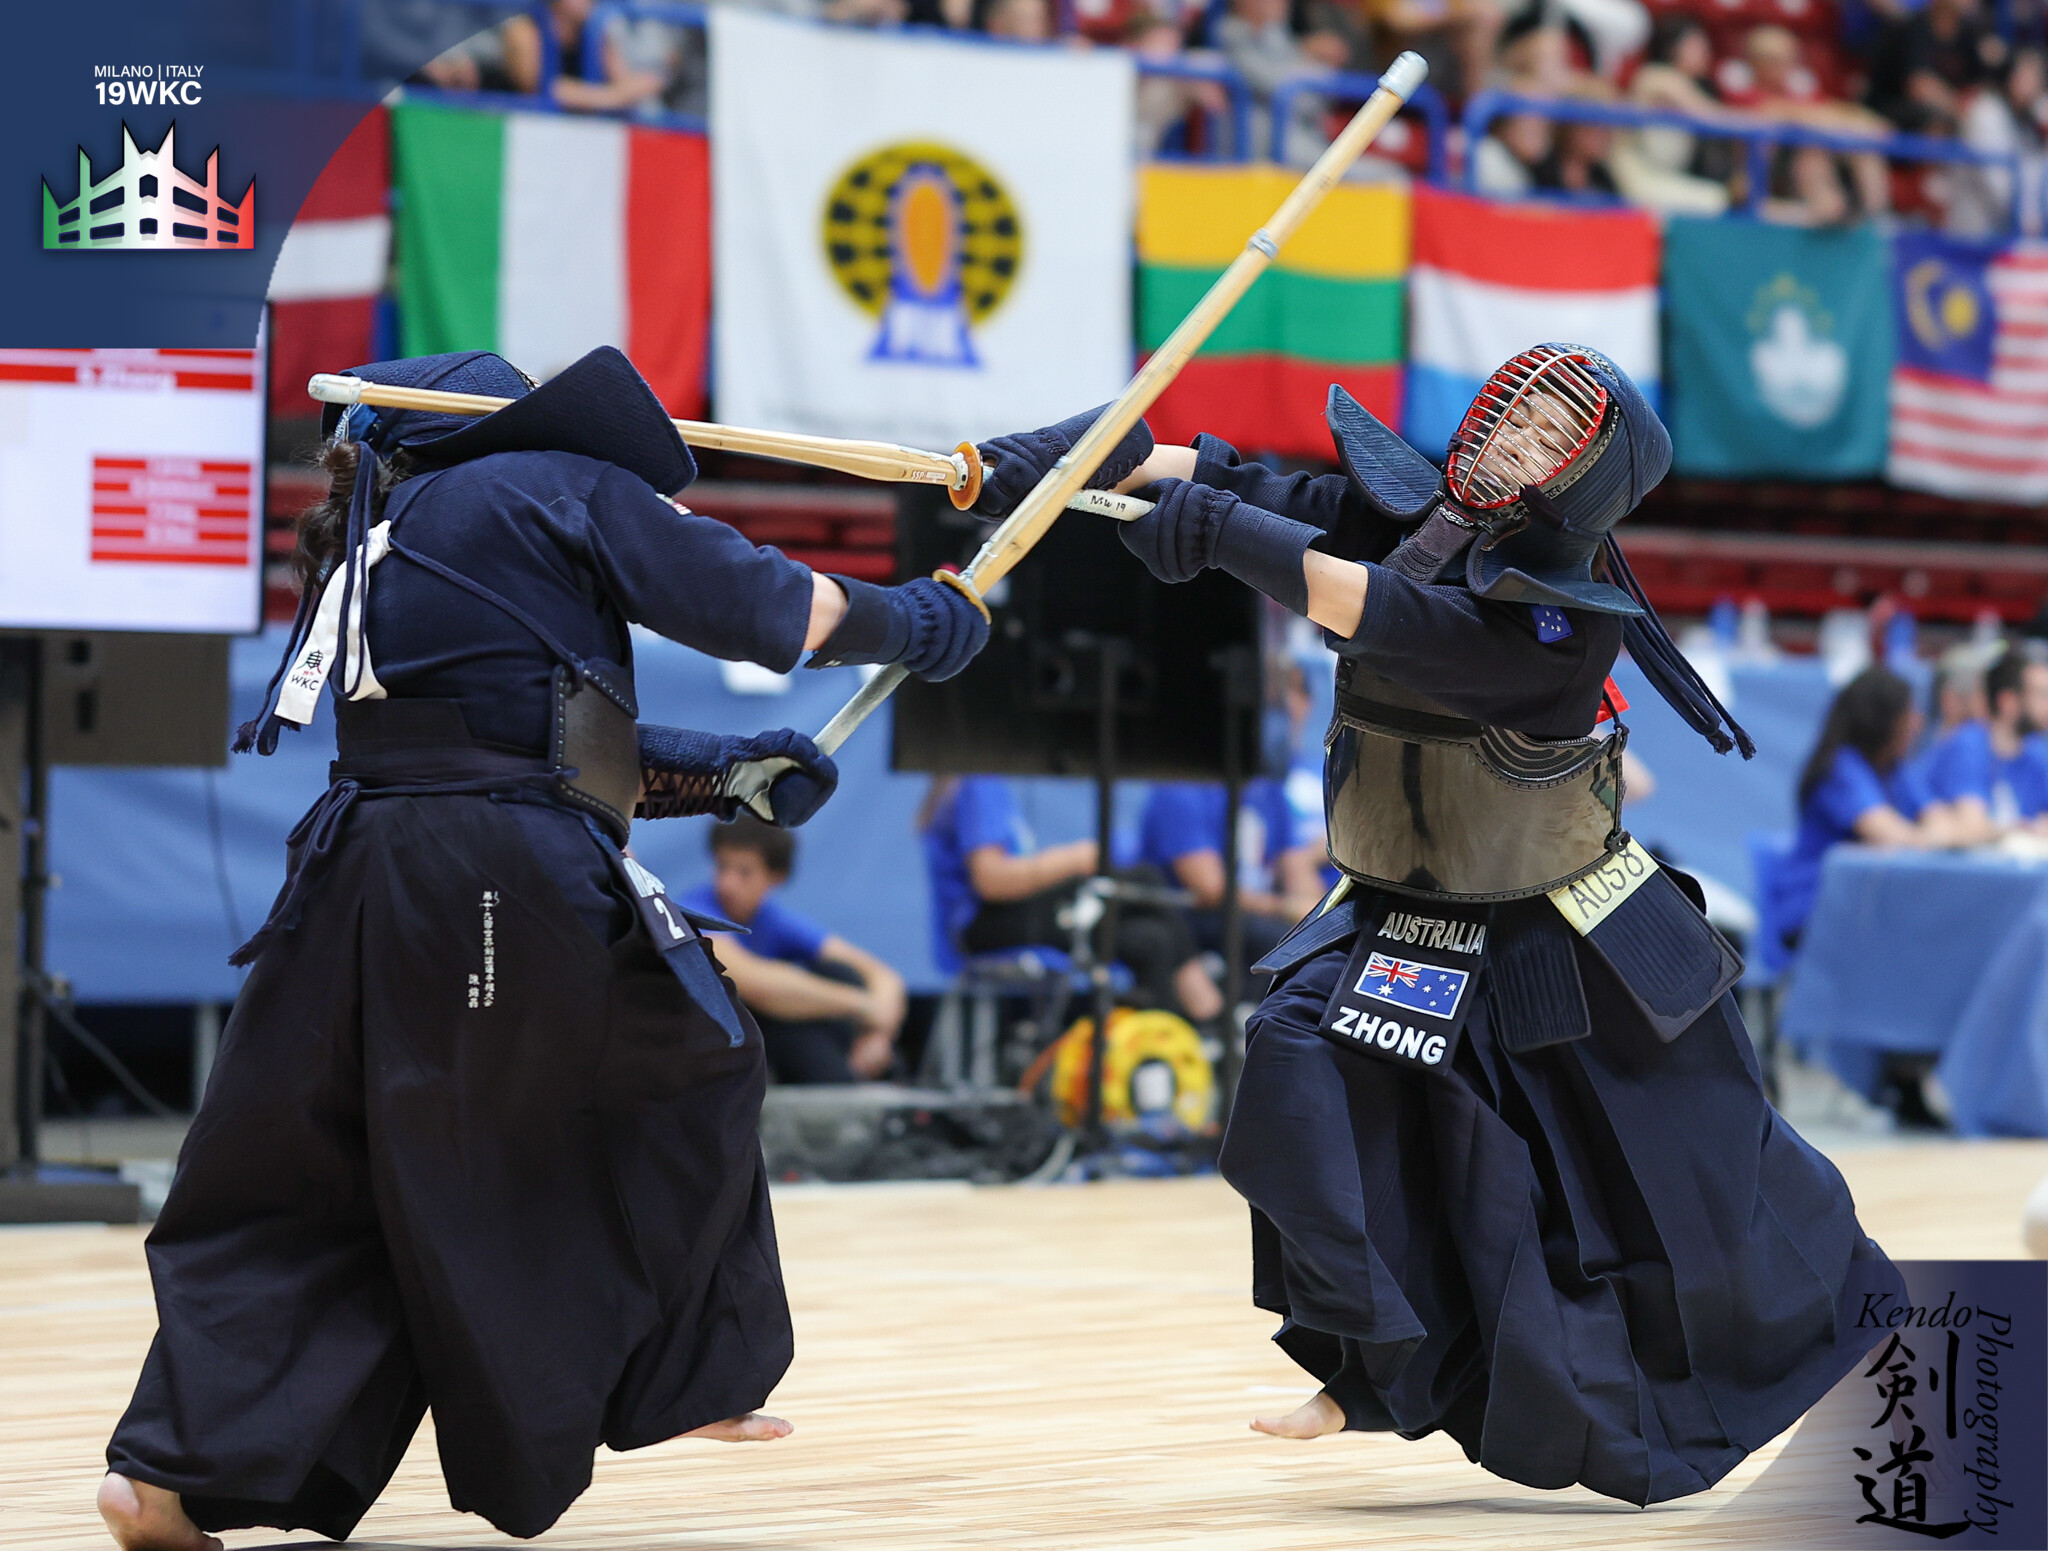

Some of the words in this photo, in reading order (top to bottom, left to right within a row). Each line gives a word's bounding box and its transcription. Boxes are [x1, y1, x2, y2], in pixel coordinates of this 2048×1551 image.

[1115, 502, 1126, 512] 19
[291, 675, 319, 691] WKC
[1568, 847, 1645, 919] AU58
[653, 897, 686, 940] 2
[1377, 912, 1487, 956] AUSTRALIA
[1331, 1006, 1447, 1065] ZHONG
